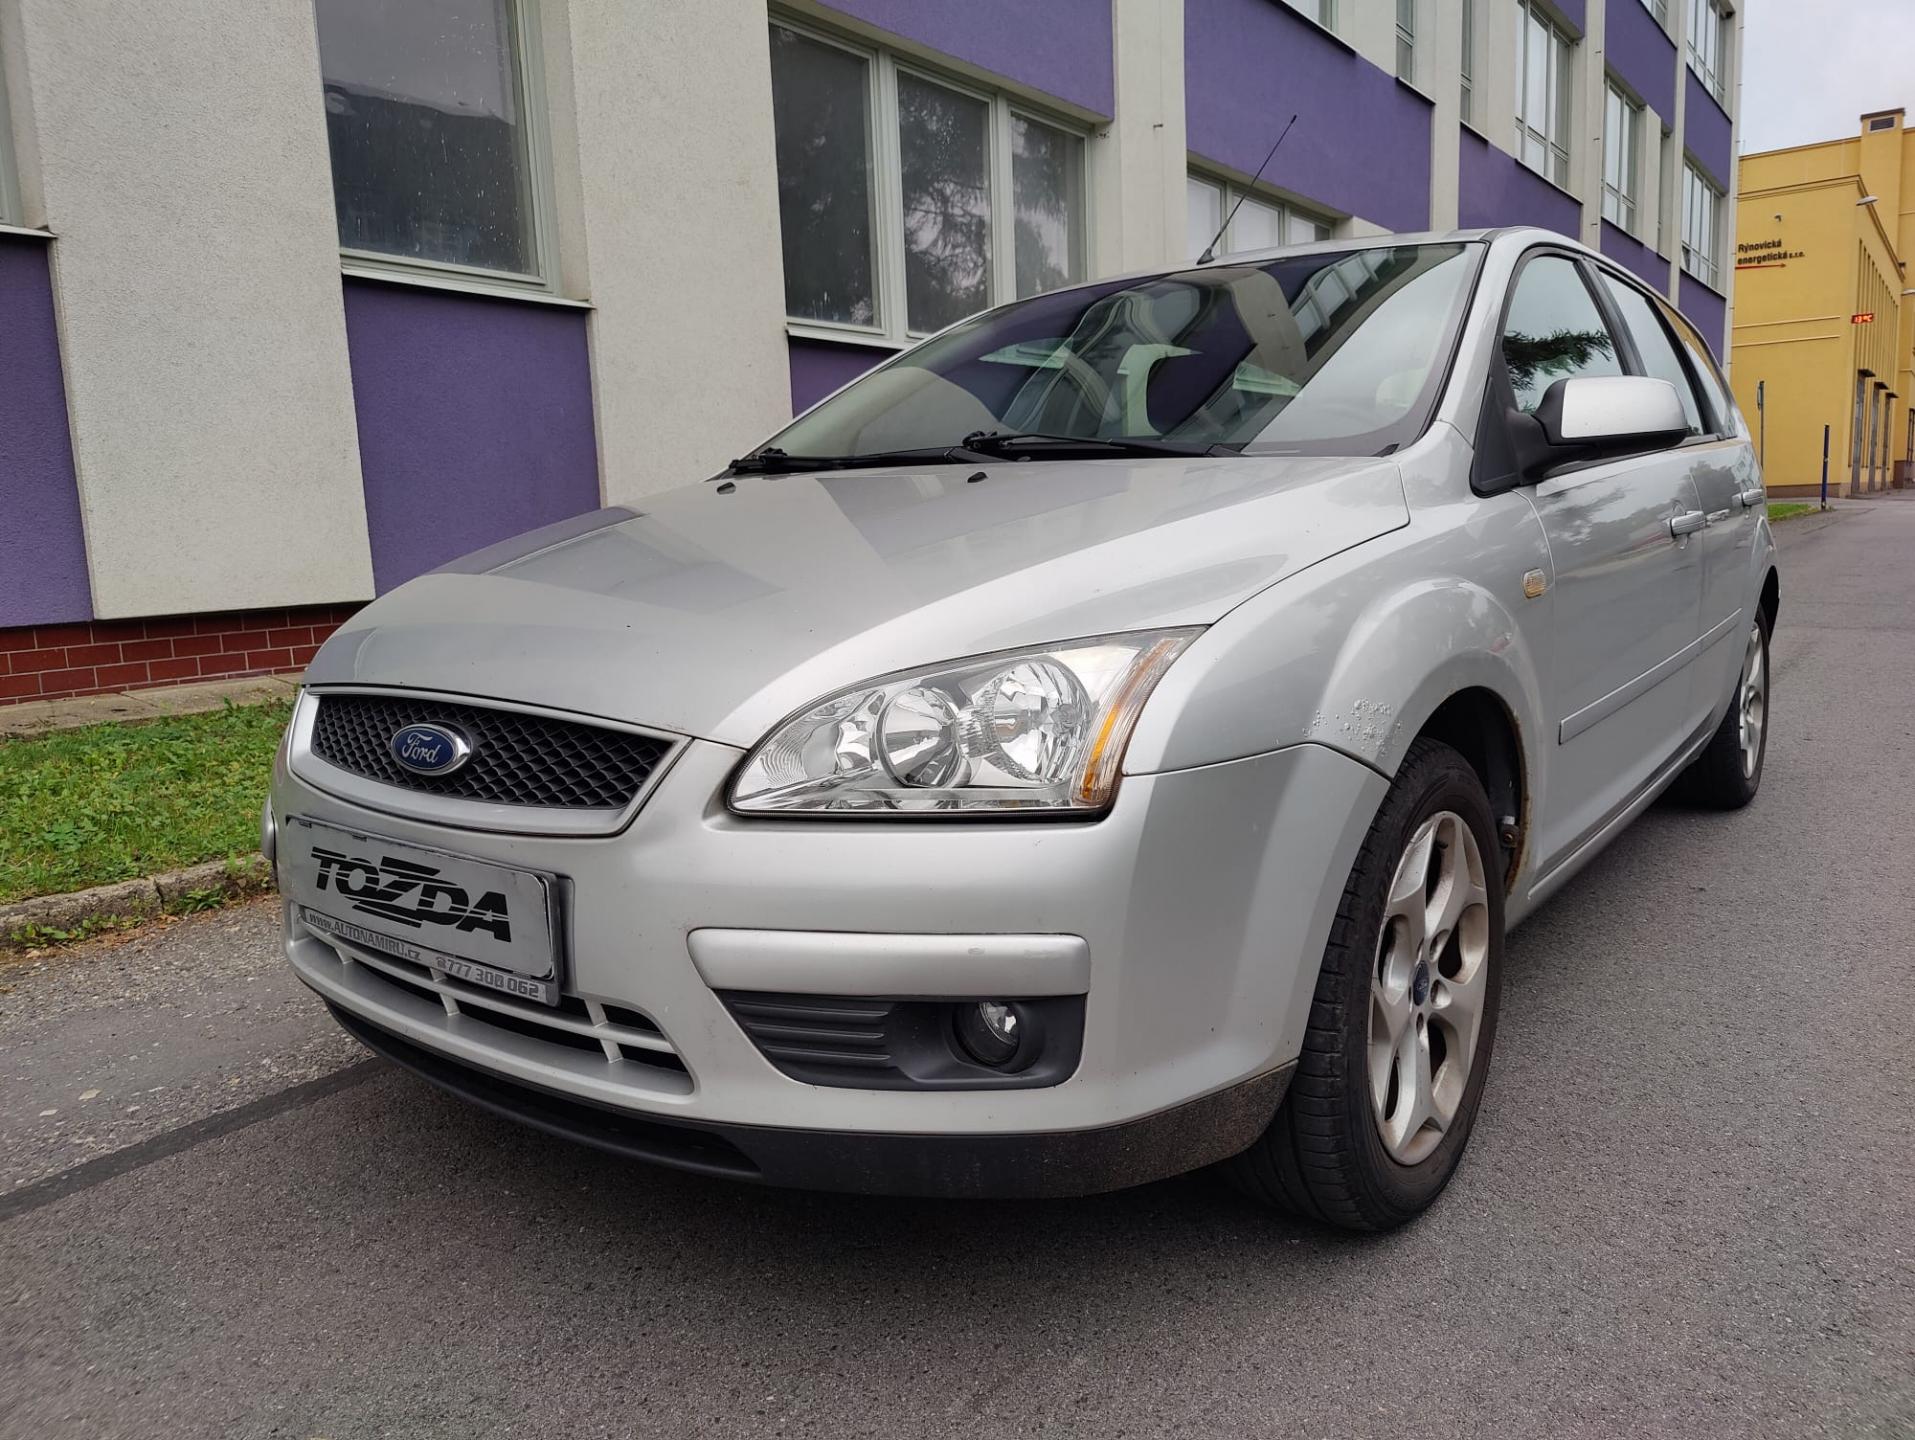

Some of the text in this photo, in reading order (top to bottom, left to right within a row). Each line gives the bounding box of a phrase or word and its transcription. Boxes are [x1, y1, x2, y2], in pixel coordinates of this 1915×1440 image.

[1737, 250, 1788, 264] energetická
[1738, 238, 1782, 253] Rýnovická
[402, 732, 441, 763] Ford
[311, 846, 511, 942] TOZDA
[447, 958, 472, 978] 777
[507, 977, 539, 998] 062
